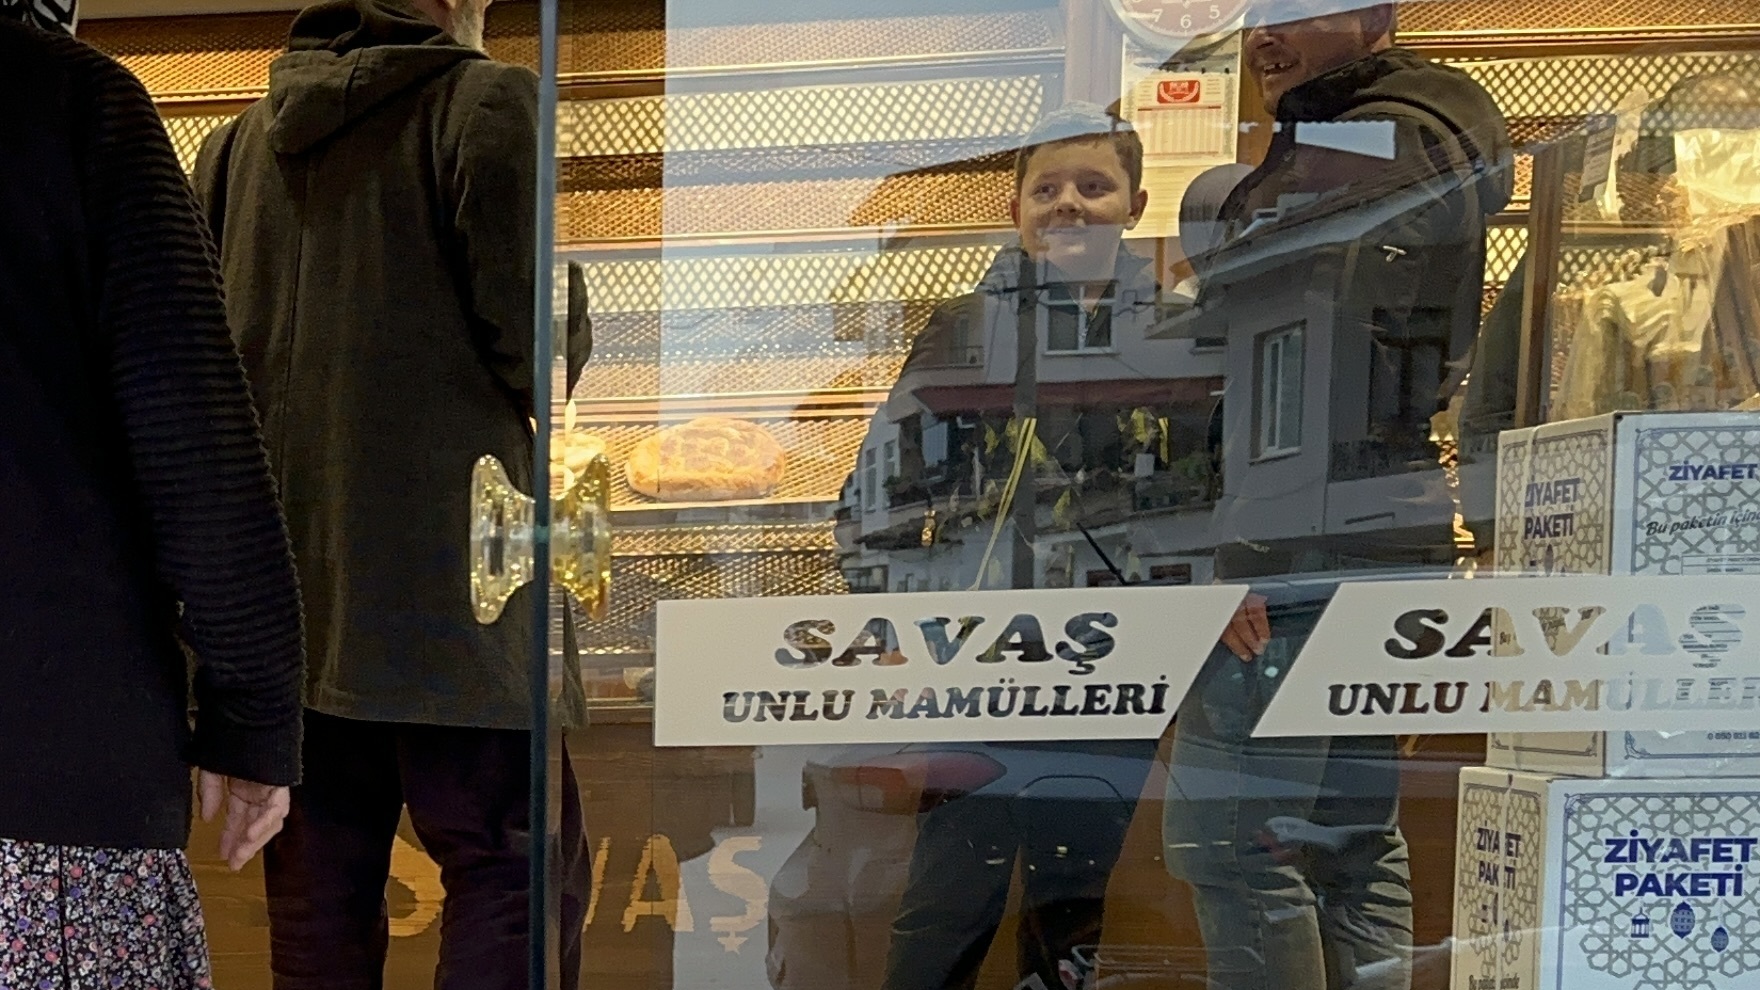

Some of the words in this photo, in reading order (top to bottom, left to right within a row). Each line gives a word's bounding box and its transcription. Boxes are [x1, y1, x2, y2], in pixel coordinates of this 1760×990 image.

[1180, 14, 1191, 29] 6
[1209, 4, 1220, 19] 5
[1668, 461, 1758, 481] ZİYAFET
[1525, 505, 1574, 540] PAKETİ
[1646, 521, 1667, 536] Bu
[1669, 513, 1727, 535] paketin
[775, 612, 1119, 675] SAVAŞ
[1384, 603, 1746, 668] SAVAŞ
[722, 690, 856, 723] UNLU
[865, 675, 1169, 720] MAMÜLLERİ
[1328, 682, 1468, 715] UNLU
[1477, 820, 1521, 858] ZİYAET
[1604, 828, 1758, 864] ZİYAFET
[1478, 860, 1516, 890] PAKTİ
[1614, 863, 1744, 897] PAKETİ
